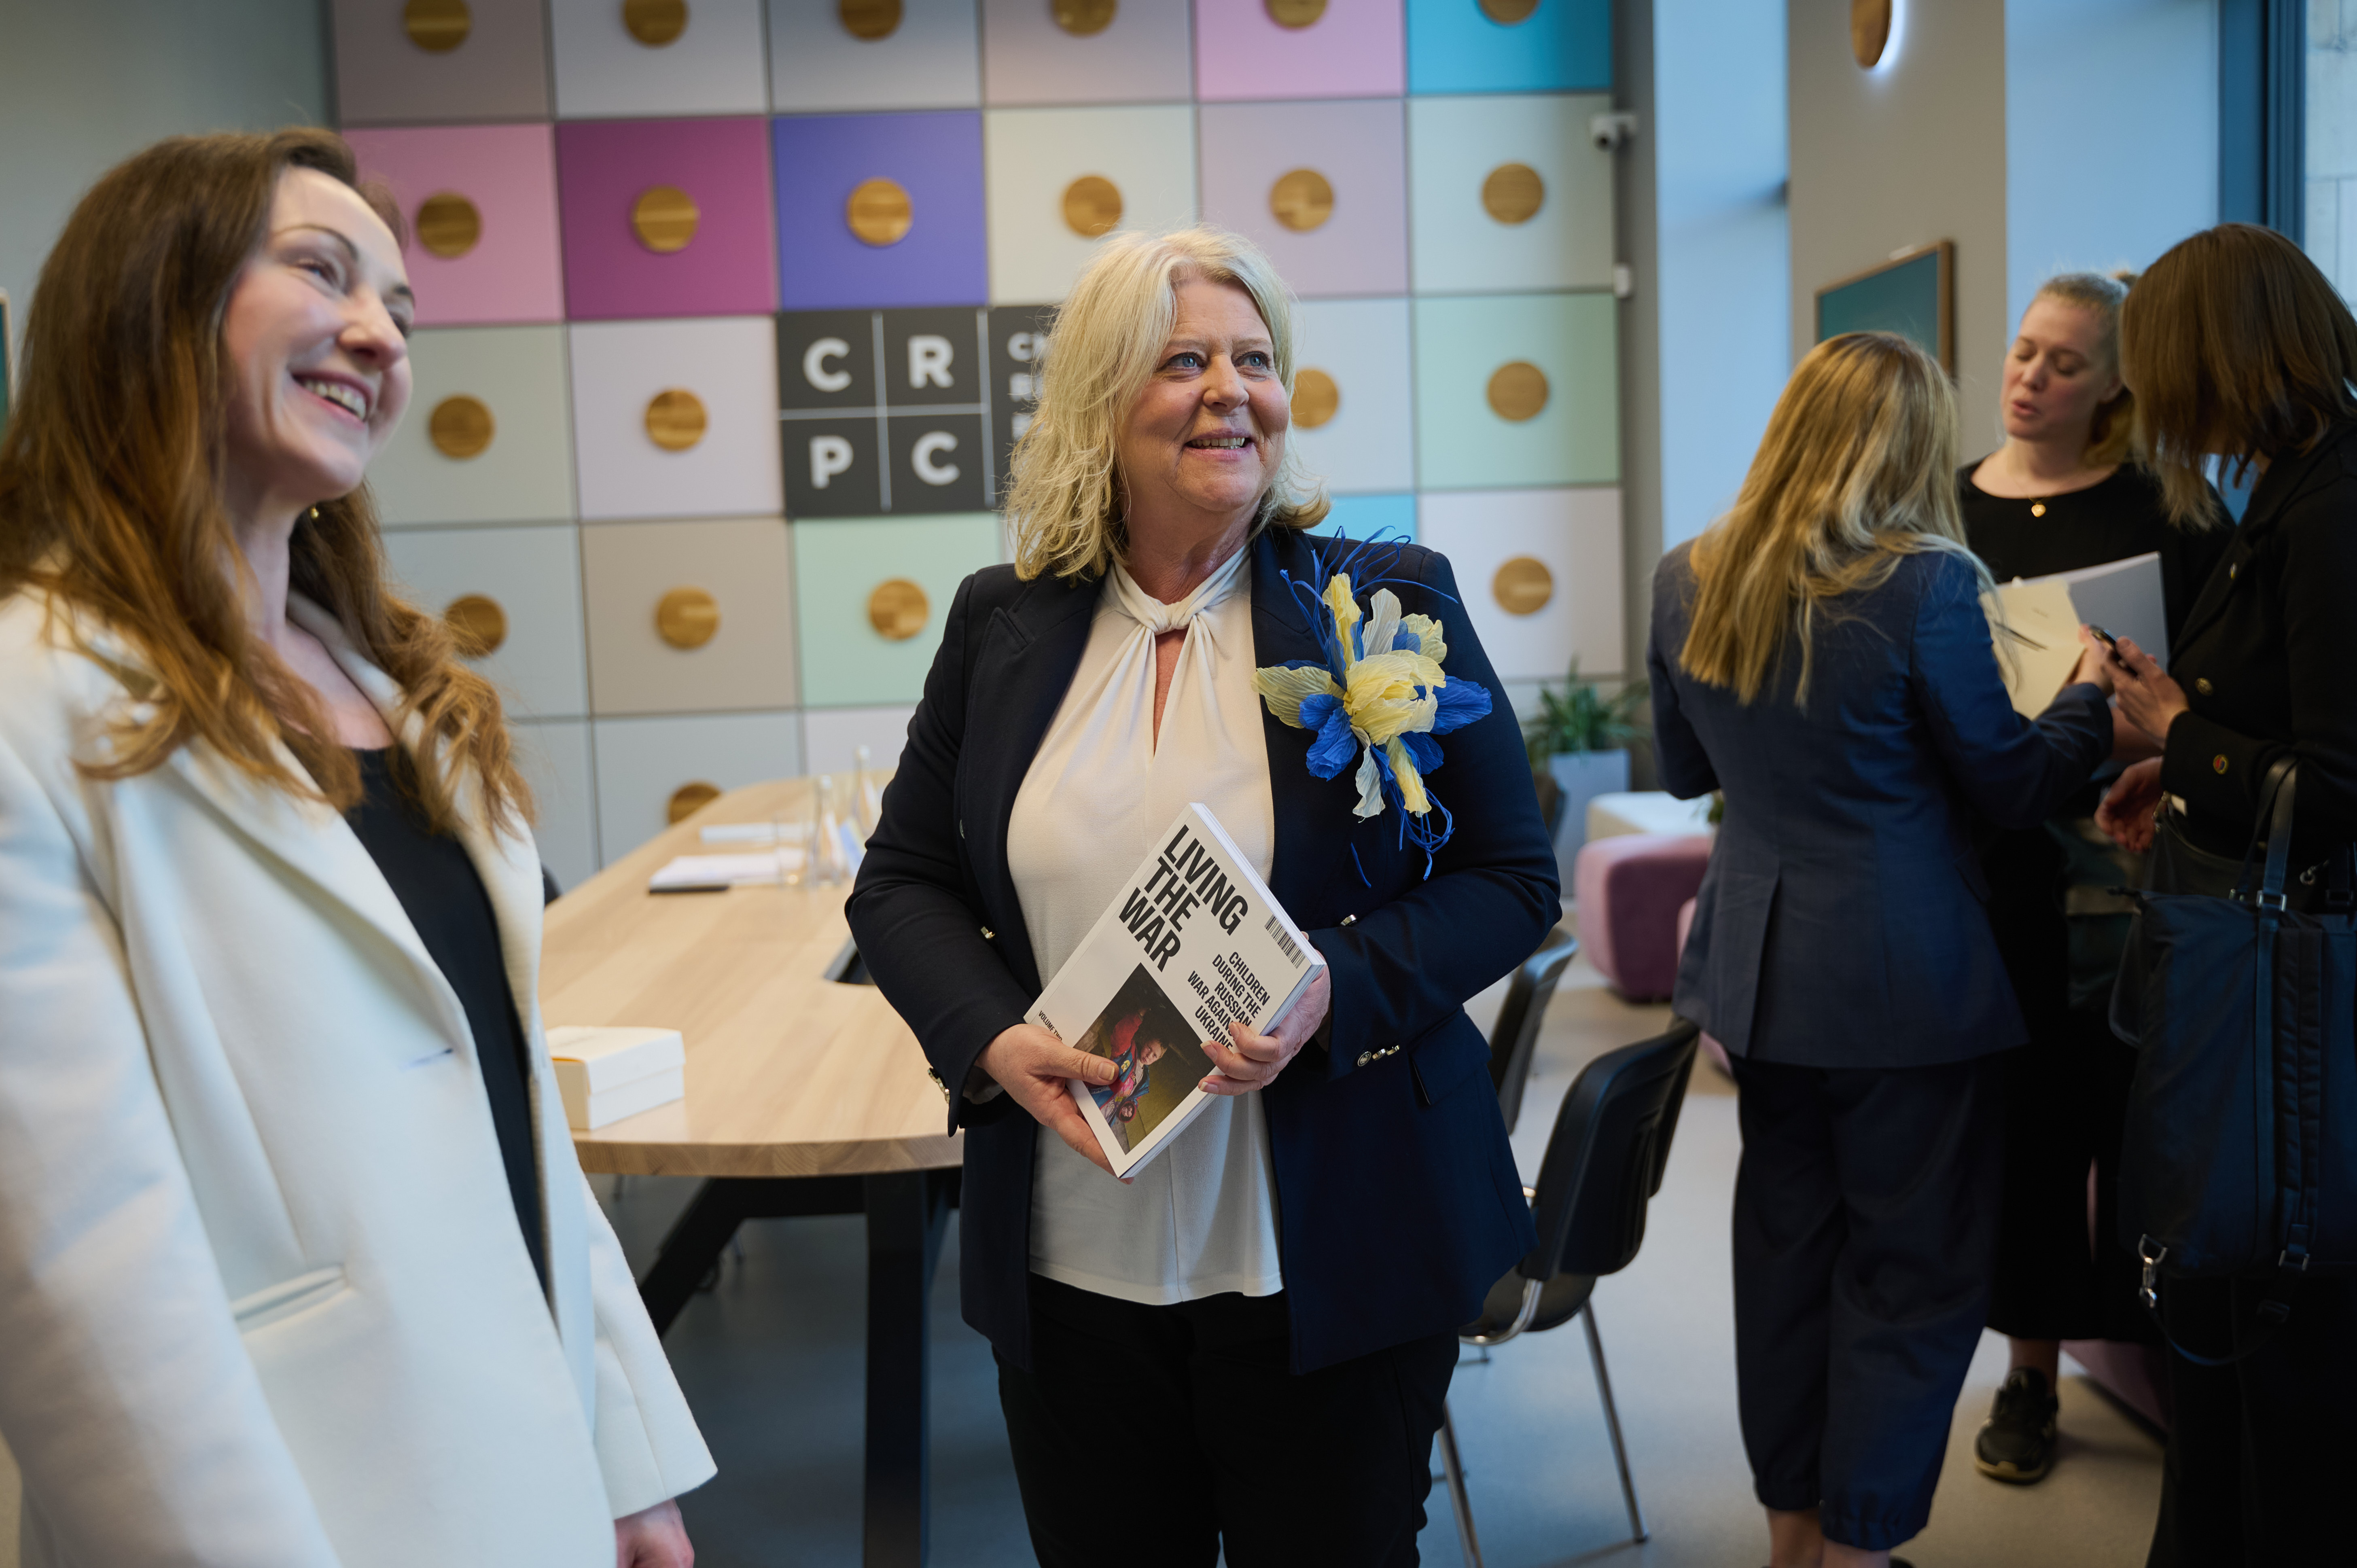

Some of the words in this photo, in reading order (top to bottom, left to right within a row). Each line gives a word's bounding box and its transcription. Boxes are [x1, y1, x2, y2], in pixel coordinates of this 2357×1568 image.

[1144, 856, 1200, 932] THE
[1164, 824, 1248, 936] LIVING
[1119, 887, 1181, 973] WAR
[1187, 970, 1209, 1000] WAR
[1205, 995, 1235, 1041] AGAIN
[1212, 954, 1245, 998] DURING
[1242, 992, 1261, 1019] THE
[1214, 981, 1252, 1027] RUSSIAN
[1229, 952, 1270, 1006] CHILDREN
[1039, 1010, 1055, 1031] VOLUME
